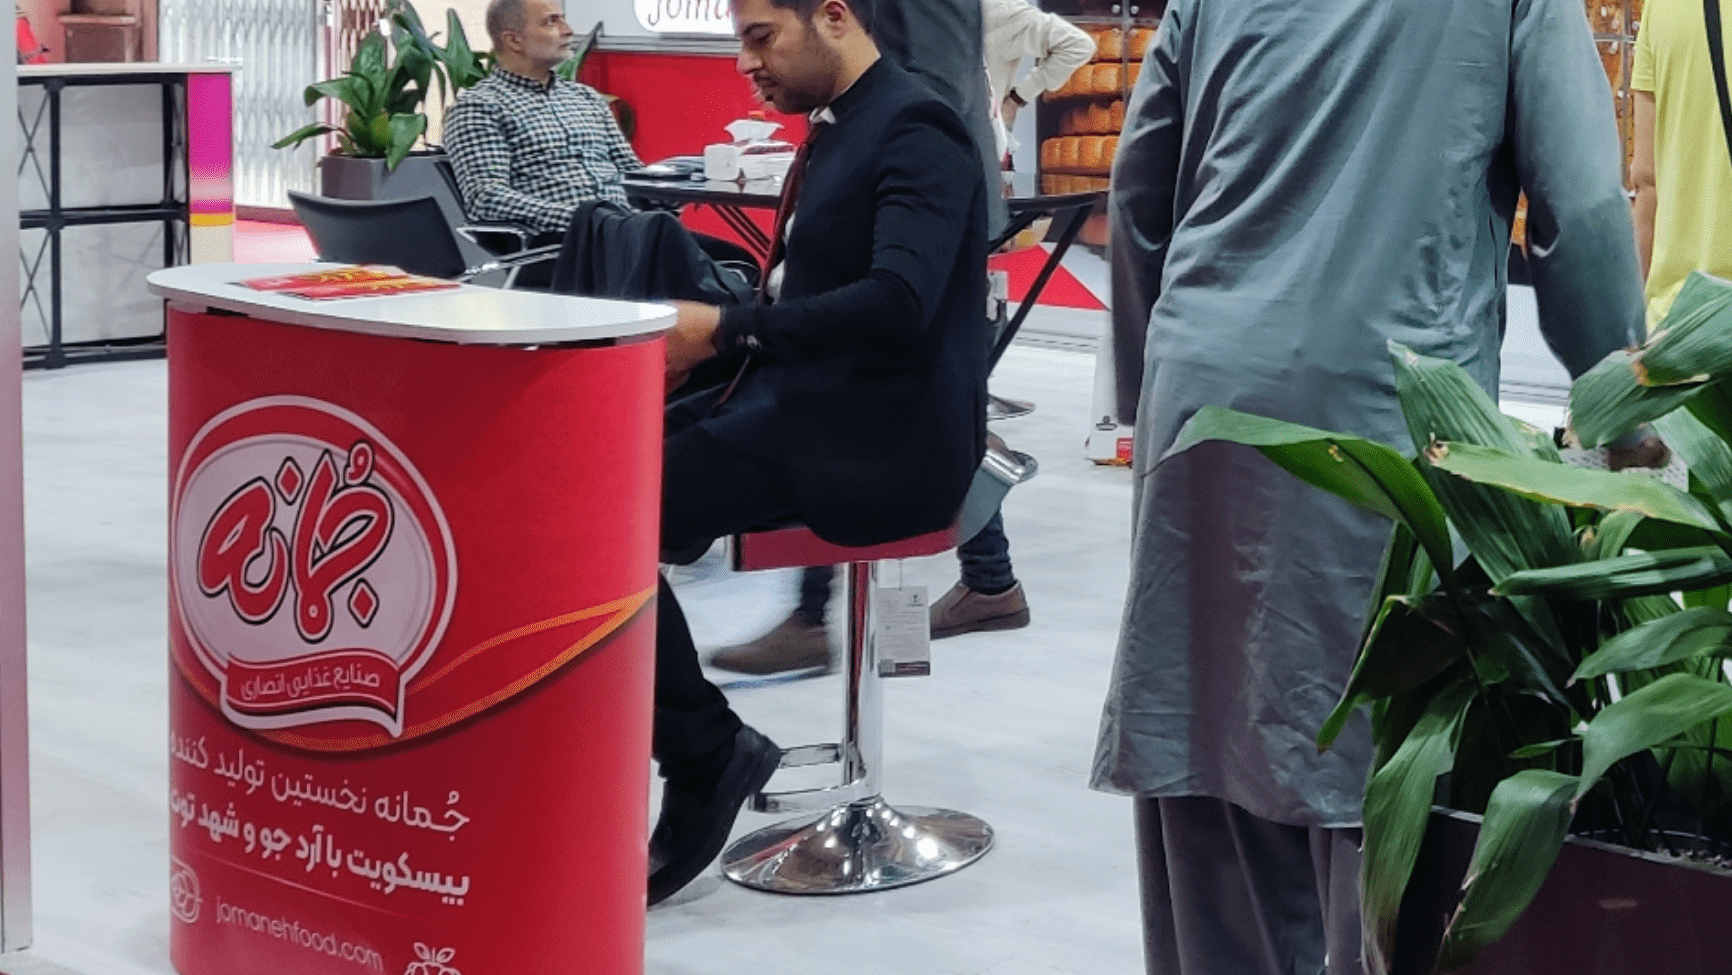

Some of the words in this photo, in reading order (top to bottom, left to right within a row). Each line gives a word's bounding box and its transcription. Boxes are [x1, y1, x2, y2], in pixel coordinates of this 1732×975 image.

[332, 663, 381, 690] صنایع
[213, 748, 266, 796] تولید
[271, 772, 367, 814] نخستین
[198, 801, 240, 843] شهد
[242, 822, 257, 854] و
[260, 826, 292, 861] جو
[296, 825, 324, 872] آرد
[325, 836, 342, 877] با
[346, 849, 471, 907] بیسکویت
[215, 895, 385, 973] jomanehfood.com
